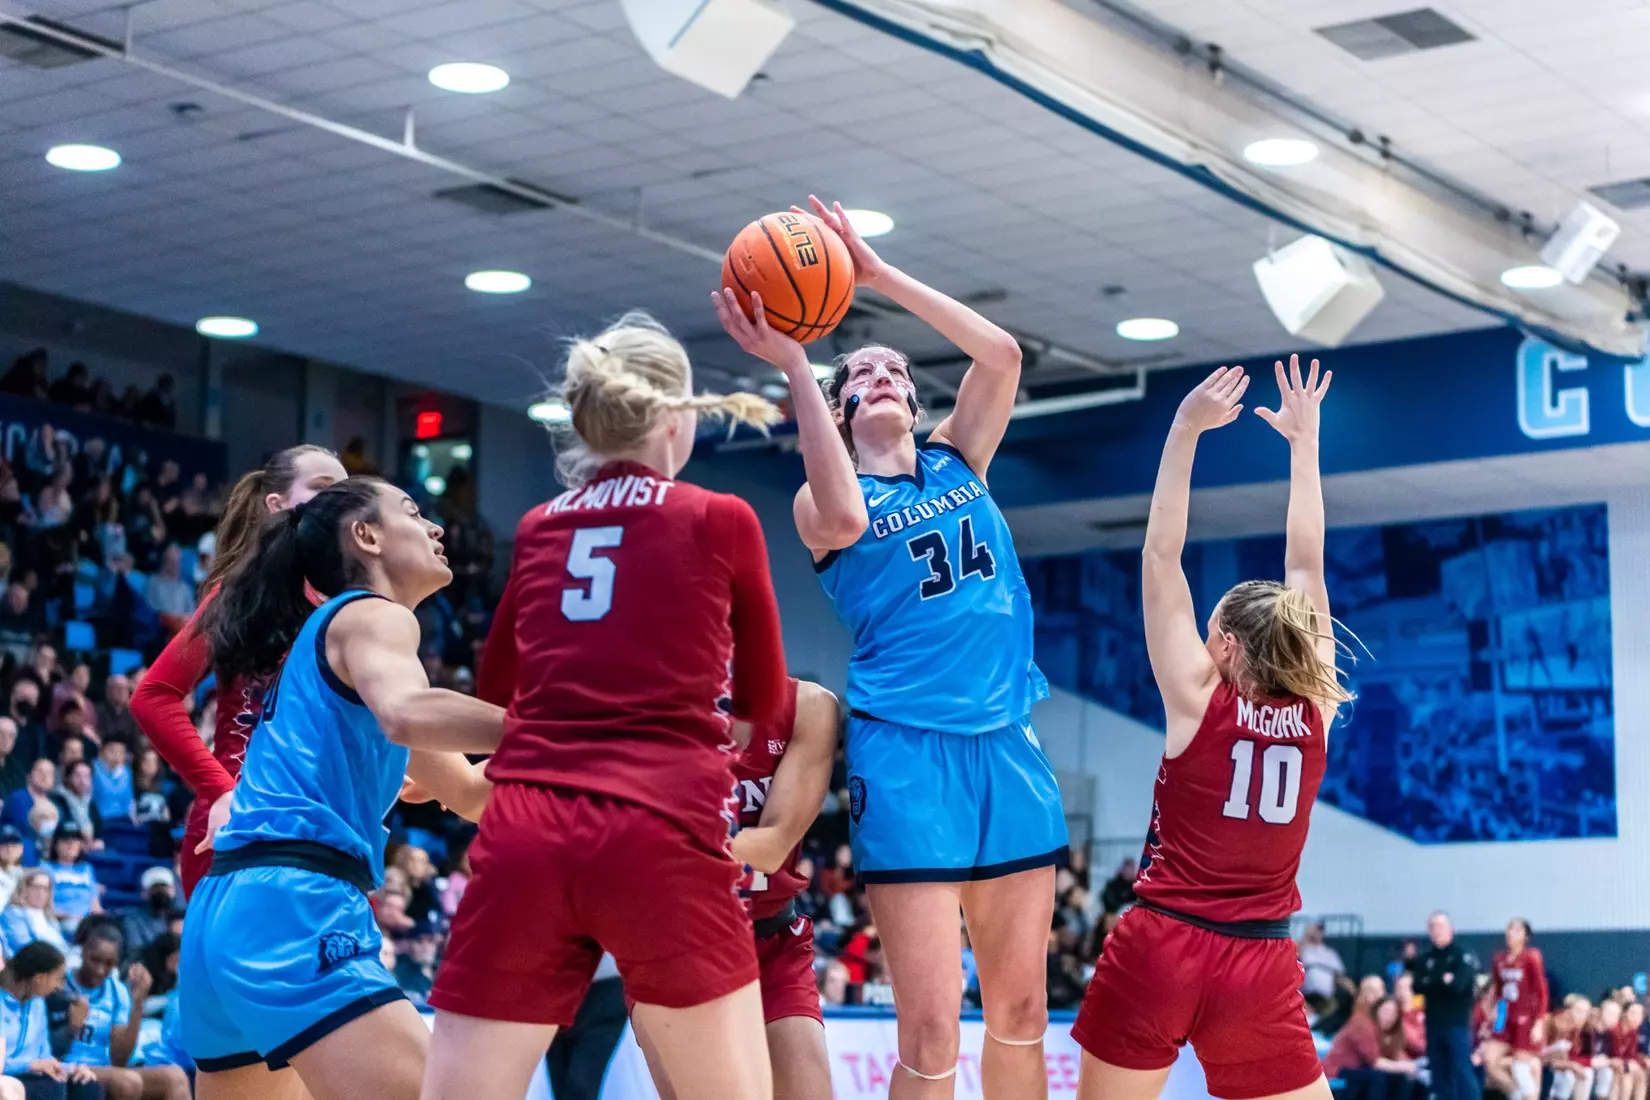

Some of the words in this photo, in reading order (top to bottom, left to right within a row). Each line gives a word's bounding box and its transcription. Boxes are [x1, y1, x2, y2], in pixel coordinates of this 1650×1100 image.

[778, 214, 819, 268] ELITE
[871, 480, 985, 540] COLUMBIA
[560, 525, 624, 623] 5
[906, 514, 997, 602] 34
[1236, 696, 1312, 739] McGURK
[1222, 738, 1304, 825] 10
